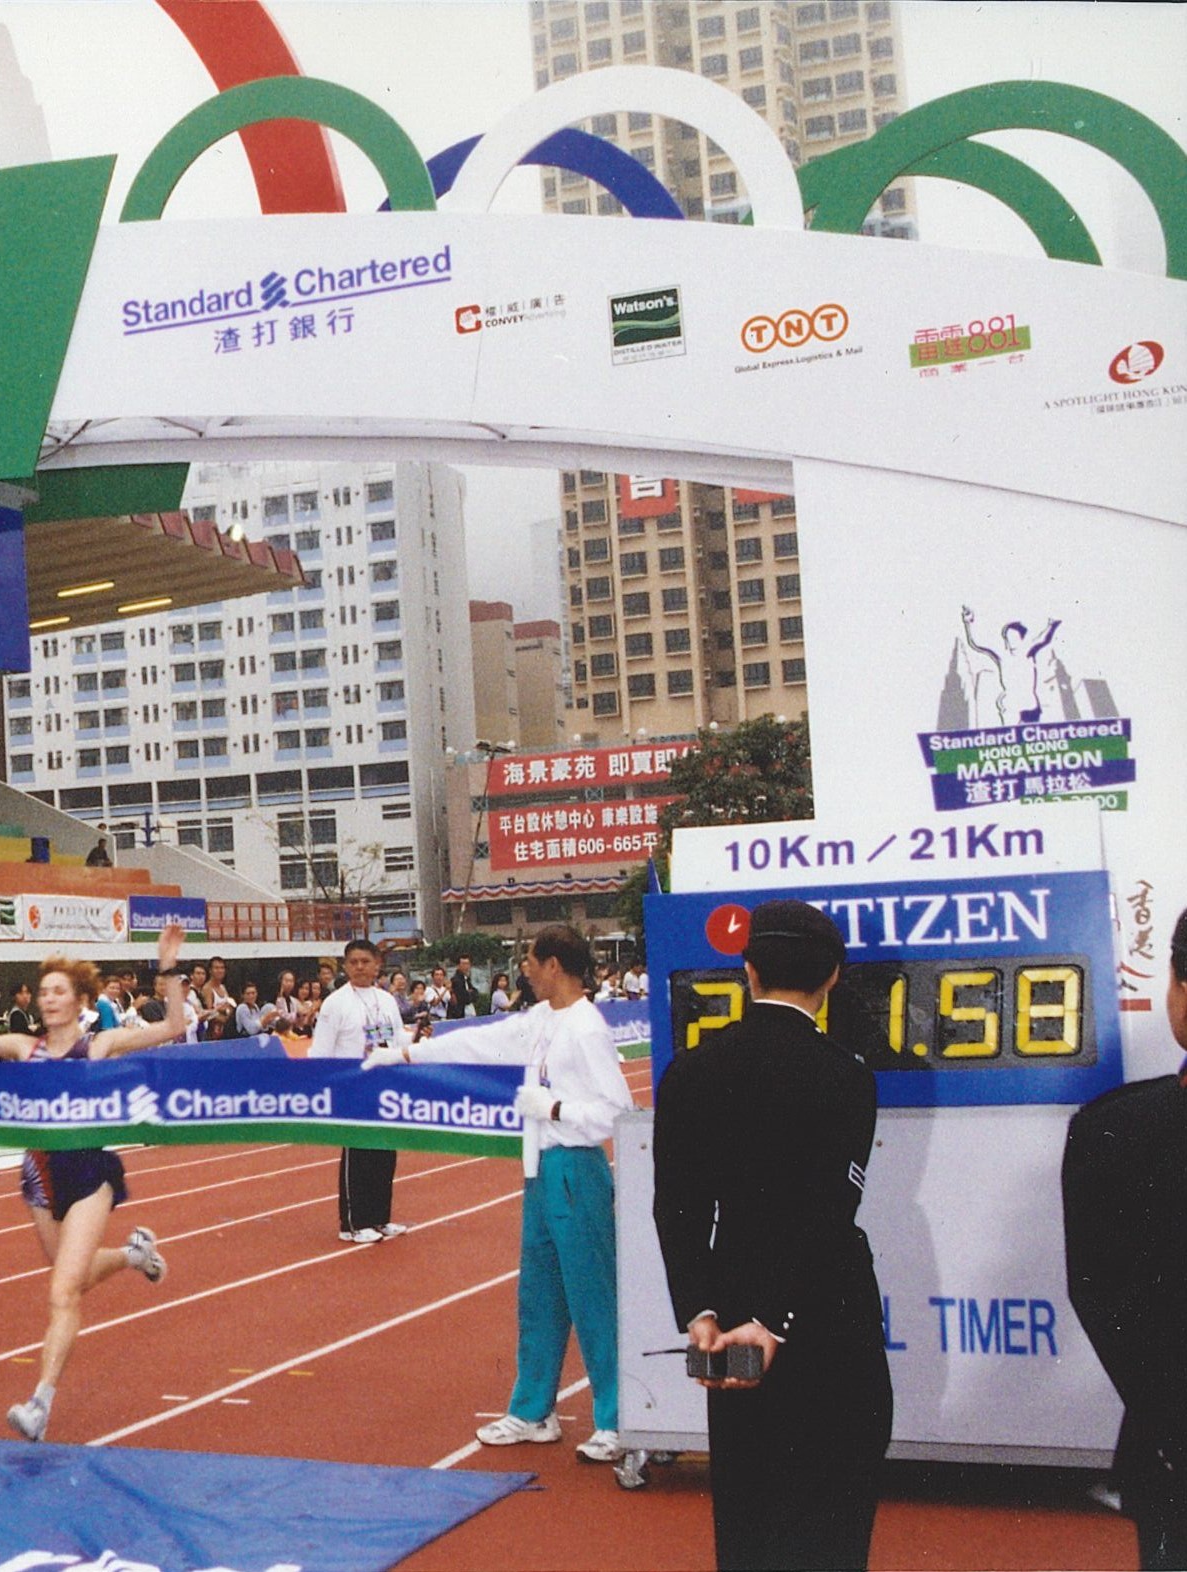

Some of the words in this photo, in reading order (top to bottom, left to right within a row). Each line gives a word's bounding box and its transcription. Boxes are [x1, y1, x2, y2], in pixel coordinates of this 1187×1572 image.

[123, 280, 253, 328] Standard
[294, 245, 452, 298] Chartered
[613, 296, 675, 315] Watson's
[746, 308, 843, 347] TNT
[845, 346, 863, 354] Mail
[929, 731, 1016, 751] Standard
[1022, 720, 1123, 743] Chartered
[978, 743, 1022, 761] HONG
[1025, 739, 1069, 756] KONG
[504, 755, 597, 786] 海景豪苑
[608, 746, 701, 777] 即買即
[957, 750, 1102, 781] MARATHON
[965, 780, 1018, 803] 渣打
[132, 913, 164, 929] Standard
[168, 1087, 332, 1118] Chartered
[379, 1090, 521, 1127] Standard
[929, 1296, 1058, 1356] TIMER
